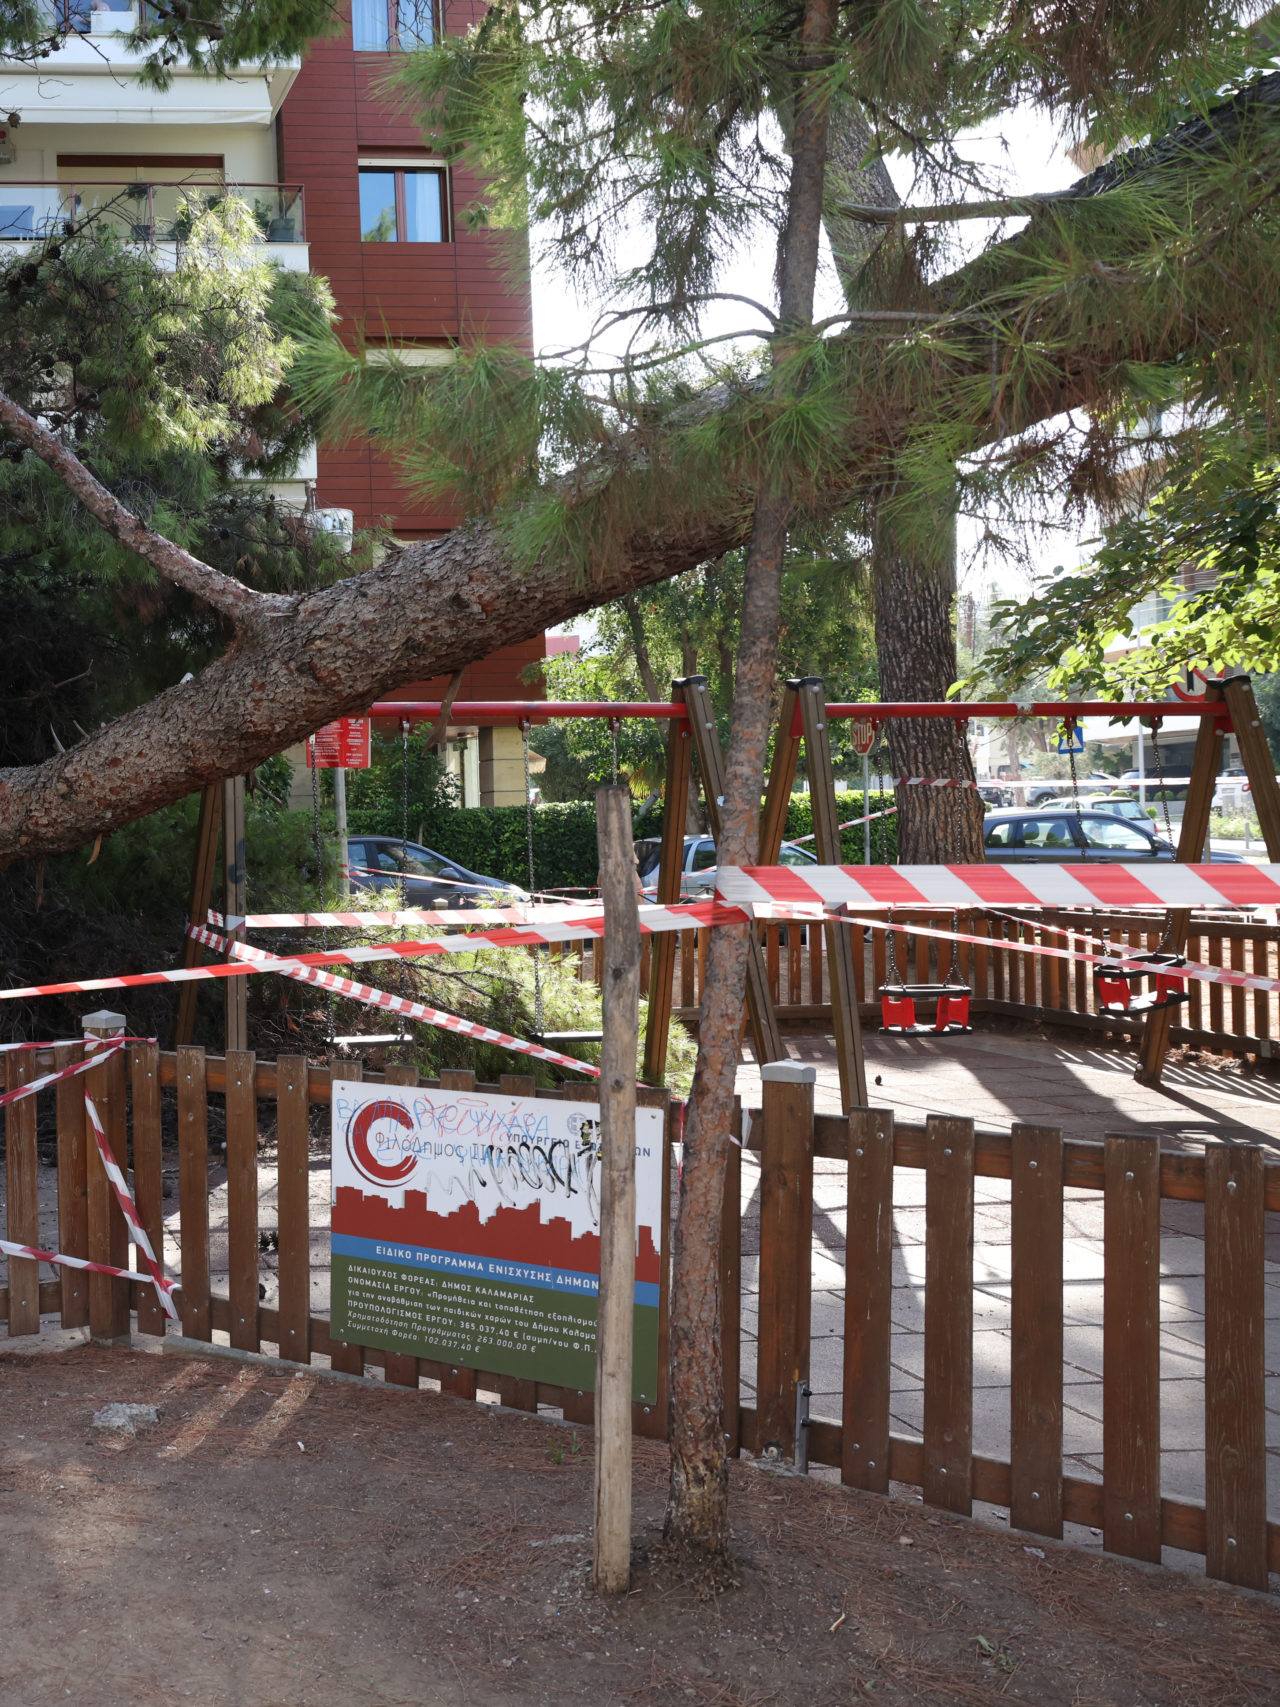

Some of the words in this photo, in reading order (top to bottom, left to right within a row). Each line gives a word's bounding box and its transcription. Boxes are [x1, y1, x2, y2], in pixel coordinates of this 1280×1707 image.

[852, 722, 873, 745] STOP
[376, 1132, 464, 1163] ΦιλόΔημος
[506, 1132, 570, 1148] ΥΠΟΥΡΓΕΙΟ
[348, 1264, 398, 1279] ΔΙΚΑΙΟΥΧΟΣ
[401, 1273, 438, 1286] ΦΟΡΕΑΣ:
[442, 1280, 472, 1292] ΔΗΜΟΣ
[475, 1286, 534, 1303] ΚΑΛΑΜΑΡΙΑΣ
[376, 1245, 412, 1259] ΕΙΔΙΚΟ
[416, 1252, 484, 1271] ΠΡΟΓΡΑΜΜΑ
[489, 1263, 552, 1282] ΕΝΙΣΧΥΣΗΣ
[556, 1275, 599, 1290] ΔΗΜΩΝ
[347, 1289, 360, 1297] για
[362, 1291, 375, 1299] την
[377, 1295, 423, 1309] αναβάθμιση
[426, 1303, 441, 1312] των
[443, 1306, 482, 1319] παιδικών
[484, 1313, 512, 1325] χαρών
[515, 1319, 529, 1328] του
[532, 1321, 559, 1334] Δήμου
[562, 1327, 596, 1340] Καλαμα
[348, 1276, 391, 1290] ΟΝΟΜΑΣΙΑ
[394, 1284, 423, 1296] ΕΡΓΟΥ:
[428, 1291, 475, 1305] «Προμήθεια
[478, 1300, 491, 1308] και
[495, 1303, 544, 1318] τοποθέτηση
[347, 1300, 423, 1320] ΠΡΟΥΠΟΛΟΓΙΣΜΟΣ
[425, 1314, 456, 1327] ΕΡΓΟΥ:
[513, 1331, 519, 1339] €
[572, 1342, 597, 1353] Φ.Π.
[347, 1310, 409, 1329] Χρηματοδότηση
[411, 1322, 474, 1341] Προγράμματος:
[530, 1345, 537, 1353] €
[347, 1320, 389, 1336] Συμμετοχή
[391, 1328, 420, 1341] Φορέα:
[475, 1345, 480, 1353] €
